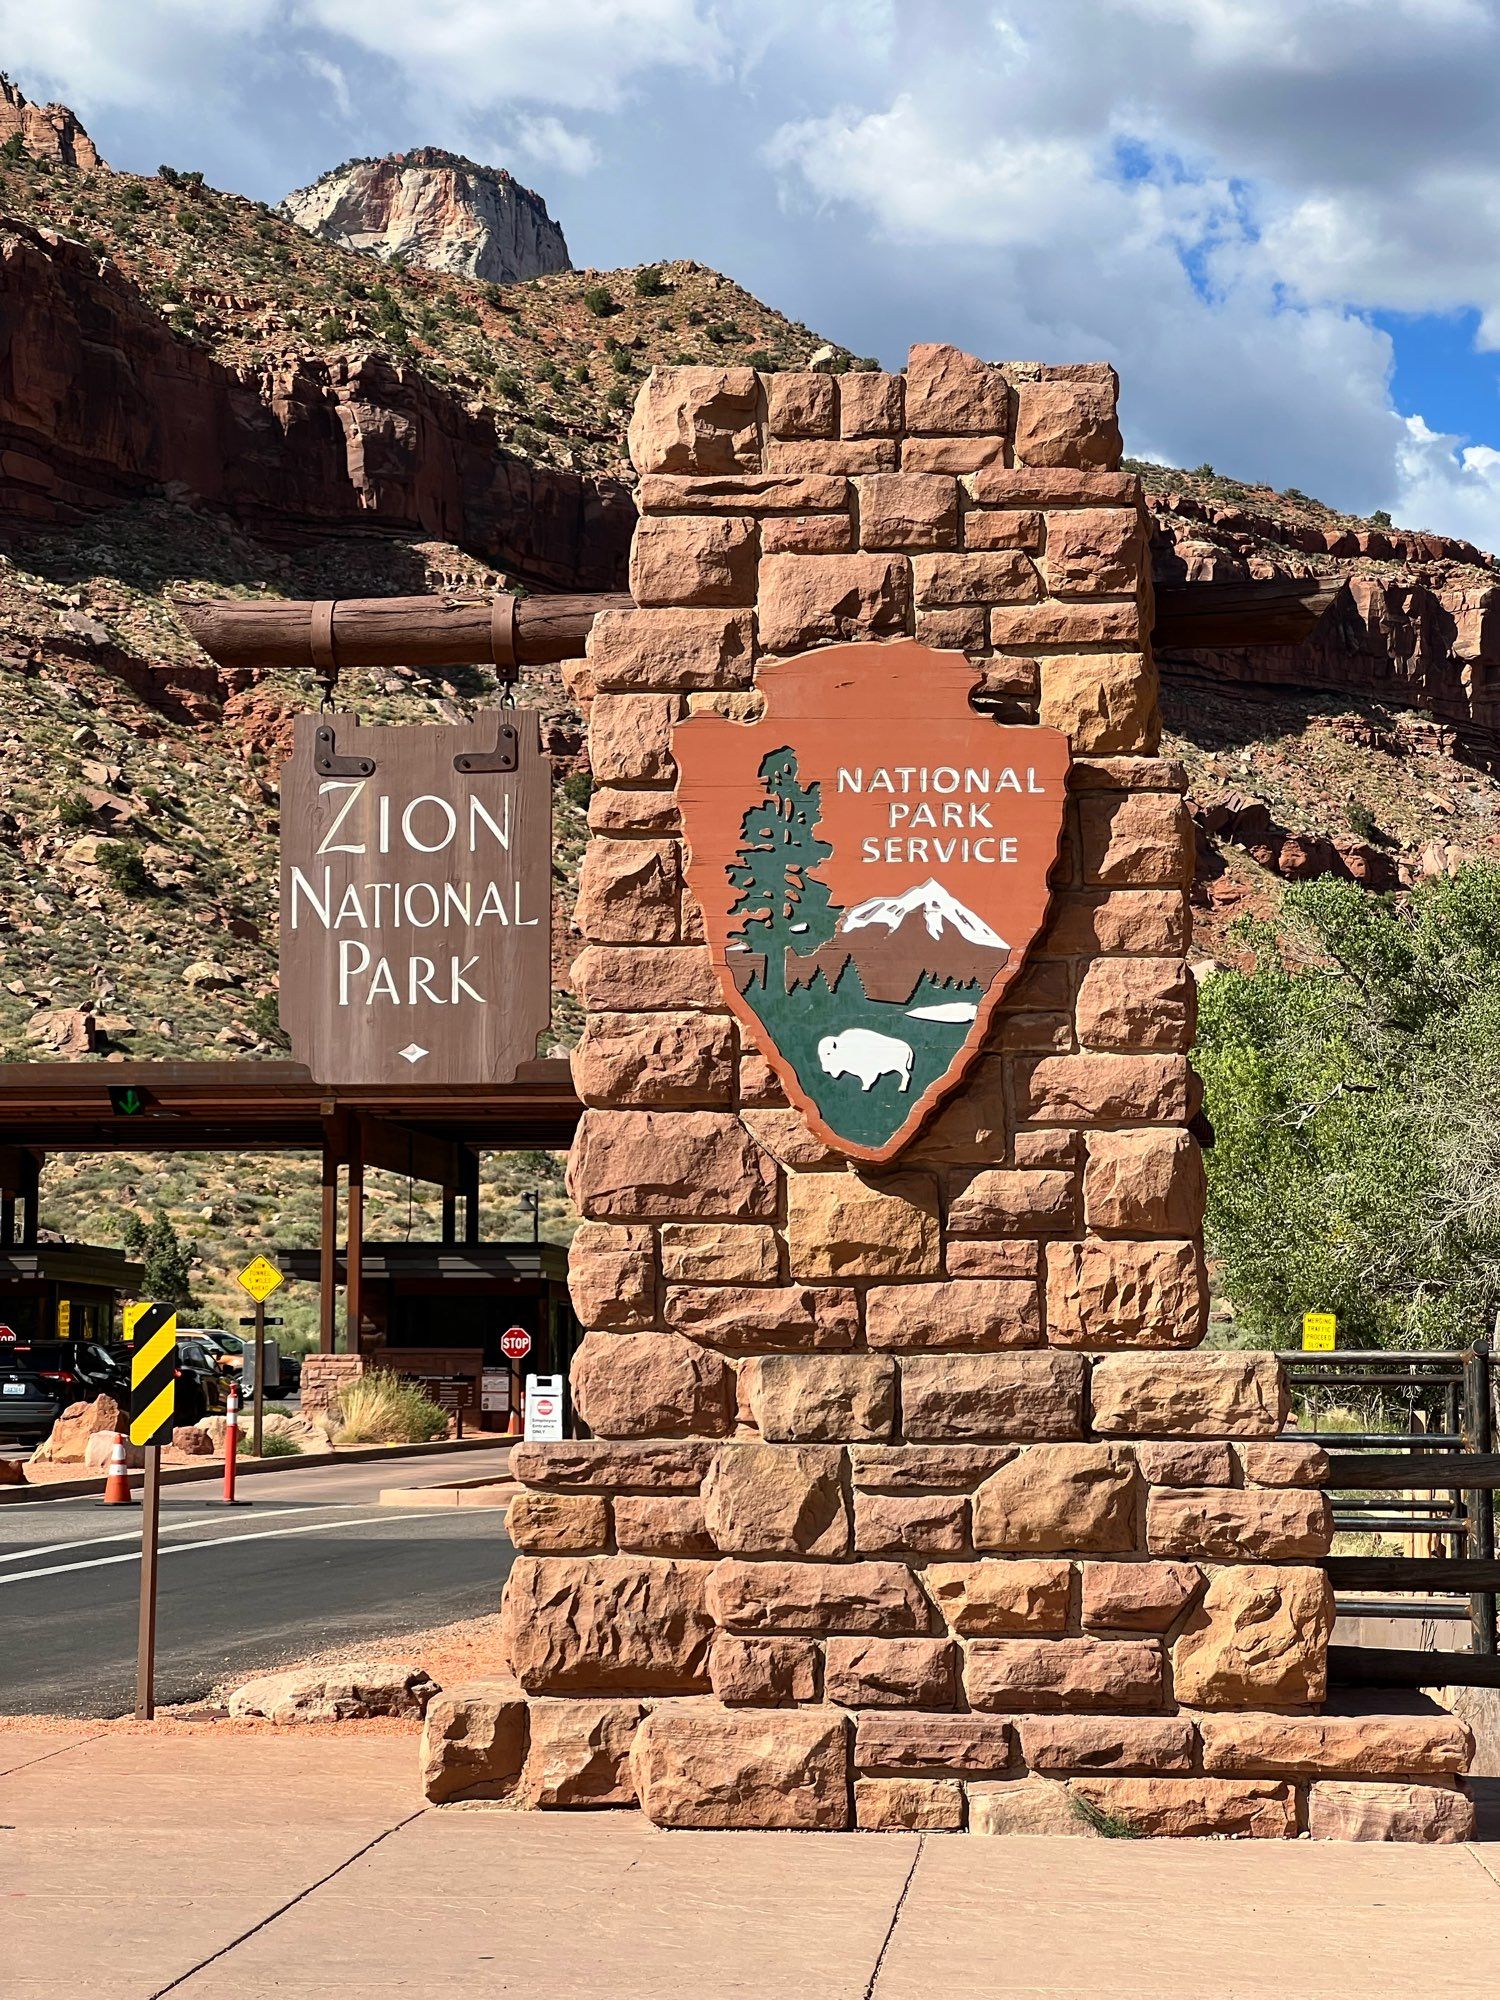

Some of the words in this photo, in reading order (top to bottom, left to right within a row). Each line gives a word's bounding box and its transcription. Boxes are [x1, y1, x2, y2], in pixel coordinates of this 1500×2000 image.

[837, 766, 1045, 794] NATIONAL
[315, 790, 509, 864] ZION
[888, 802, 993, 828] PARK
[861, 836, 1018, 863] SERVICE
[290, 865, 539, 929] NATIONAL
[338, 940, 487, 1006] PARK
[1307, 1317, 1332, 1325] MERGING
[503, 1337, 529, 1349] STOP
[1306, 1333, 1332, 1341] PROCEED
